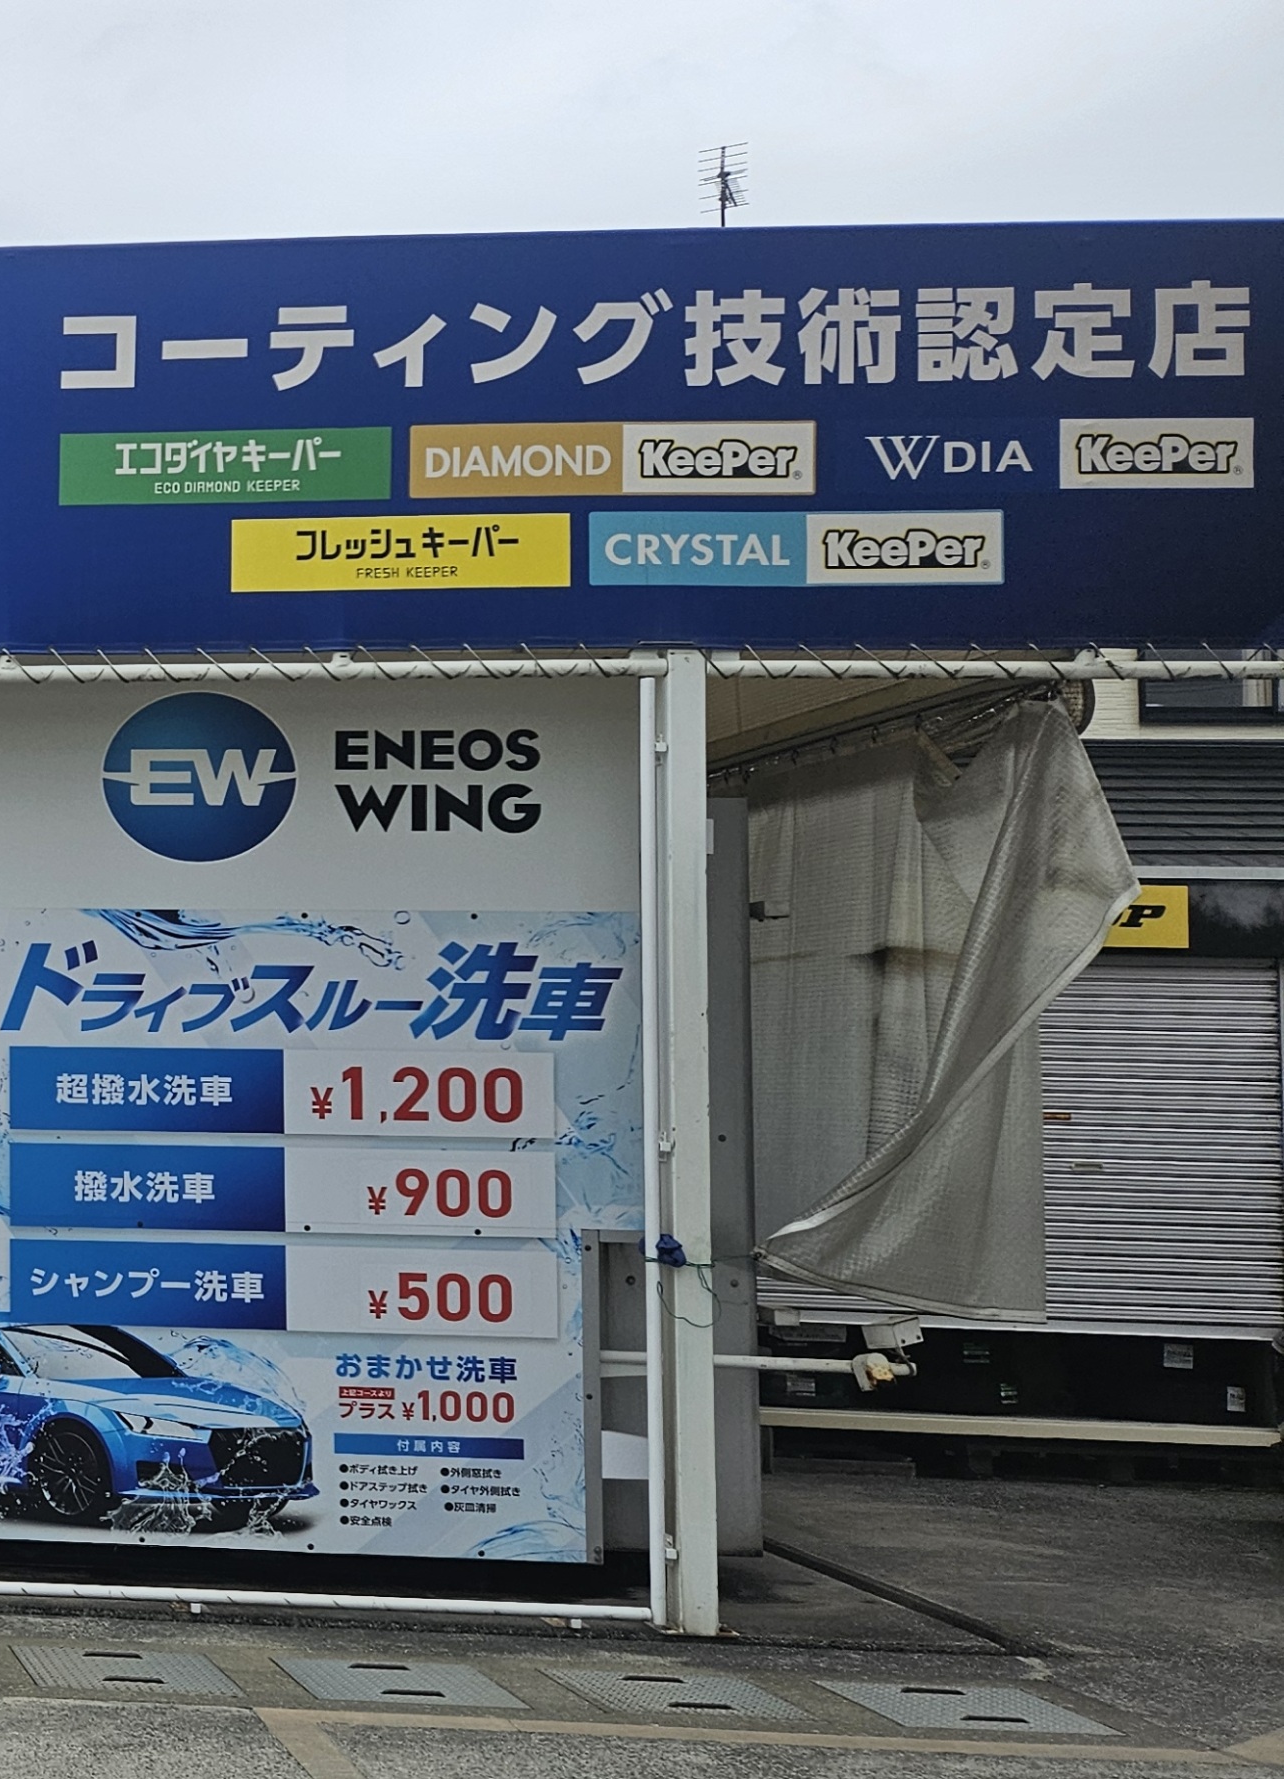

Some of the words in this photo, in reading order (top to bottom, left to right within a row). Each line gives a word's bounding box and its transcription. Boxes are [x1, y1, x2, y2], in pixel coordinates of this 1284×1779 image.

[59, 280, 1253, 390] コーティング技術認定店
[115, 437, 341, 475] エコダイヤキーパー
[425, 445, 611, 478] DIAMOND
[639, 439, 797, 478] KeePer
[1076, 434, 1238, 474] KeePer
[154, 482, 180, 494] ECO
[184, 481, 241, 493] DIAMOND
[247, 479, 300, 492] KEEPER
[296, 525, 519, 561] フレッシュキーパー
[604, 533, 790, 567] CRYSTAL
[824, 529, 986, 569] KeePer
[356, 567, 400, 579] FRESH
[406, 566, 458, 578] KEEPER
[334, 729, 541, 772] ENEOS
[130, 748, 277, 806] EW
[334, 784, 542, 834] WING
[1112, 905, 1166, 928] P
[0, 940, 623, 1041] ドライブスルー洗車
[56, 1073, 233, 1107] 超撥水洗車
[310, 1066, 523, 1124] ¥1,200
[74, 1170, 216, 1205] 撥水洗車
[367, 1168, 513, 1218] ¥900
[29, 1268, 265, 1304] シャンプー洗車
[368, 1272, 514, 1323] ¥500
[335, 1353, 517, 1384] おまかせ洗車
[339, 1401, 395, 1420] プラス
[402, 1390, 515, 1423] ¥1,000
[341, 1389, 392, 1398] 上記コースより
[397, 1439, 461, 1453] 付属内容
[349, 1464, 418, 1476] ボディ拭き上げ
[450, 1467, 502, 1478] 外側窓拭き
[349, 1482, 428, 1493] ドアステップ拭き
[450, 1485, 521, 1497] タイヤ外側拭き
[350, 1499, 417, 1511] タイヤワックス
[350, 1516, 392, 1527] 安全点検
[454, 1503, 497, 1513] 灰皿清掃
